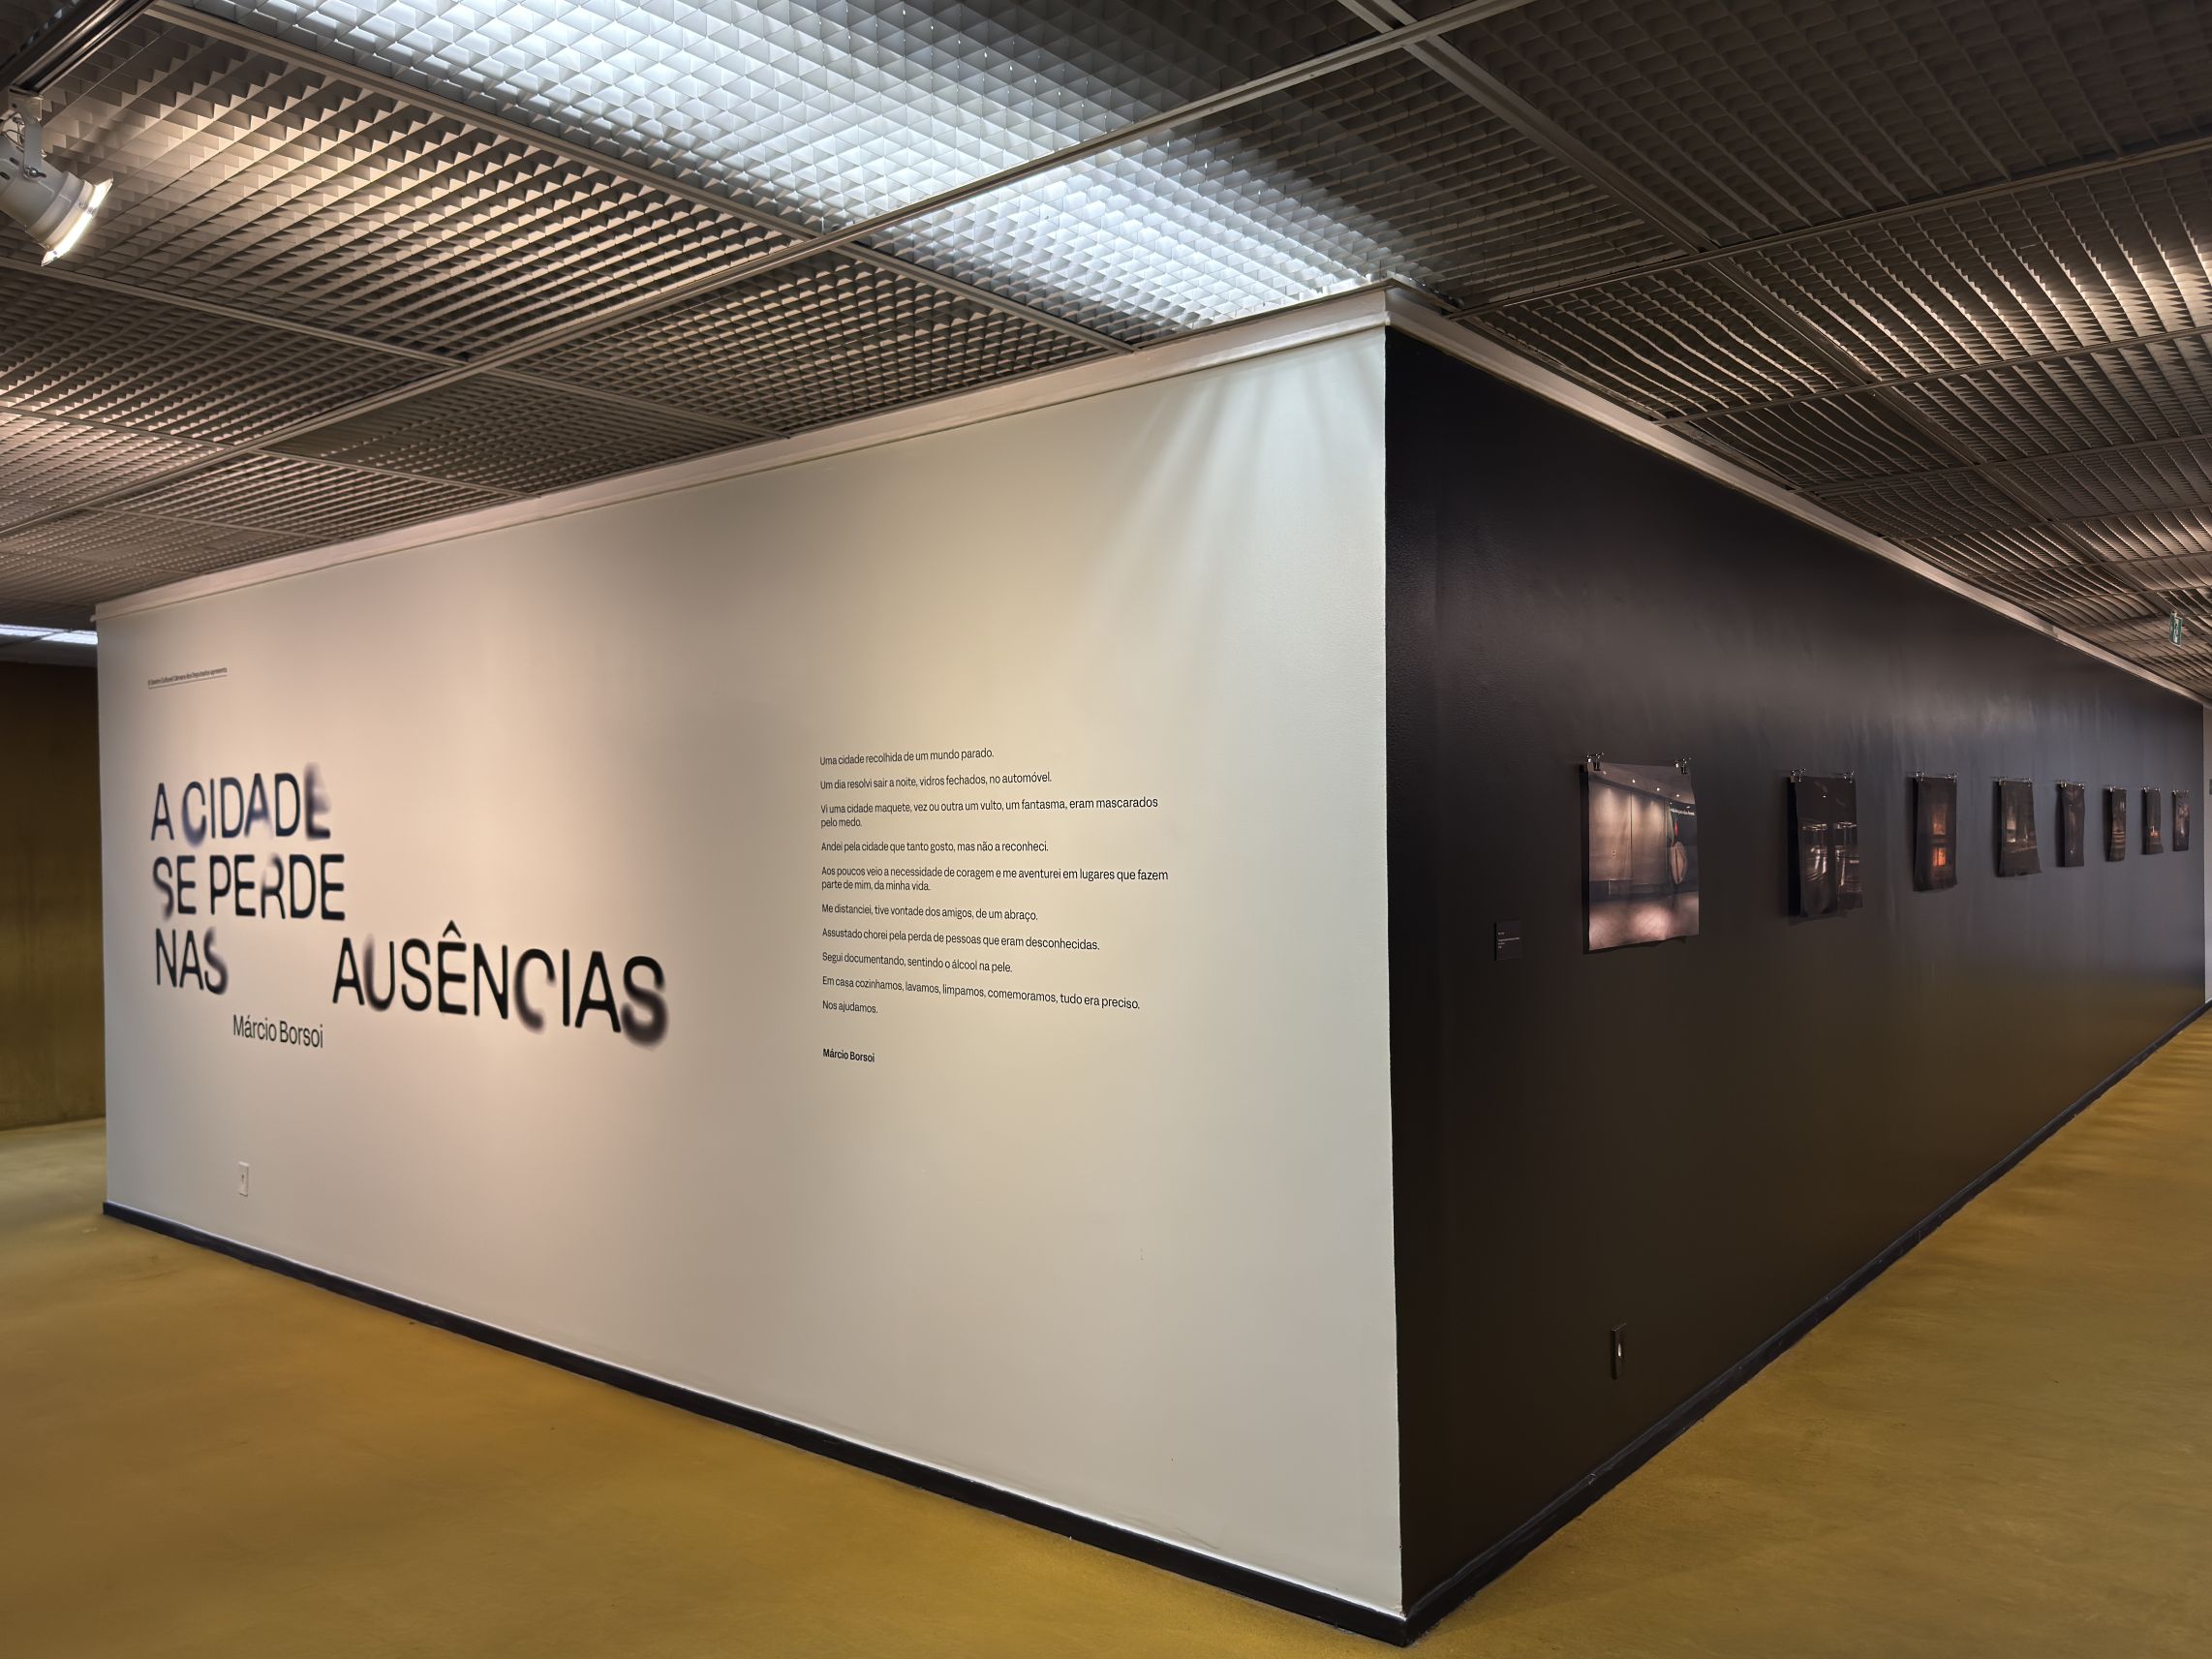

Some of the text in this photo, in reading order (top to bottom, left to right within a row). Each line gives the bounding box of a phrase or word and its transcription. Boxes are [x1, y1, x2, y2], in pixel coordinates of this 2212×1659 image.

[820, 756, 837, 765] Uma
[838, 754, 864, 764] cidade
[866, 753, 903, 763] recolhida
[904, 752, 914, 761] de
[930, 750, 960, 760] mundo
[961, 748, 994, 760] parado.
[820, 781, 834, 789] Um
[834, 780, 845, 788] dia
[847, 778, 872, 788] resolvi
[874, 778, 888, 787] sair
[896, 777, 918, 787] noite,
[920, 776, 944, 786] vidros
[946, 775, 988, 785] fechados,
[1002, 772, 1052, 783] automóvel.
[151, 761, 331, 846] A CIDADE
[821, 805, 828, 814] Vi
[847, 803, 873, 813] cidade
[875, 803, 912, 814] maquete,
[941, 802, 964, 812] outra
[966, 802, 979, 811] um
[980, 800, 1004, 812] vulto,
[1022, 799, 1067, 810] fantasma,
[1069, 799, 1094, 809] eram
[1096, 796, 1158, 808] mascarados
[821, 817, 862, 829] pelo medo.
[821, 842, 843, 851] Andei
[845, 842, 860, 852] pela
[862, 842, 889, 851] cidade
[890, 845, 905, 853] que
[906, 843, 929, 851] tanto
[931, 843, 956, 853] gosto,
[977, 842, 994, 851] não
[1001, 841, 1048, 851] reconheci.
[821, 867, 836, 876] Aos
[837, 868, 866, 877] poucos
[867, 867, 883, 876] veio
[891, 868, 942, 876] necessidade
[944, 868, 955, 877] de
[957, 870, 995, 879] coragem
[1002, 870, 1017, 878] me
[1019, 869, 1061, 878] aventurei
[1062, 871, 1078, 879] em
[1080, 869, 1115, 881] lugares
[1117, 871, 1136, 882] que
[1137, 870, 1169, 880] fazem
[152, 852, 346, 921] SE PERDE
[821, 881, 842, 890] parte
[844, 880, 853, 889] de
[874, 880, 884, 890] da
[886, 880, 910, 890] minha
[821, 904, 834, 913] Me
[875, 906, 889, 914] tive
[890, 906, 924, 916] vontade
[925, 906, 940, 917] dos
[941, 908, 974, 920] amigos,
[976, 908, 987, 918] de
[989, 910, 1002, 919] um
[1004, 909, 1038, 922] abraço.
[822, 928, 1100, 950] Assustado chorei pela perda de pessoas que eram desconhecidas.
[822, 952, 844, 964] Segui
[845, 953, 906, 967] documentando,
[907, 957, 943, 968] sentindo
[952, 959, 977, 970] álcool
[992, 962, 1012, 973] pele.
[155, 919, 670, 1050] NAS AUSÊNCIAS
[822, 976, 1140, 1009] Em casa cozinhamos, lavamos, limpamos, comemoramos, tudo era preciso.
[822, 1000, 878, 1013] Nos ajudamos.
[232, 1014, 323, 1049] Márcio Borsoi
[823, 1048, 875, 1062] Márcio Borsoi
